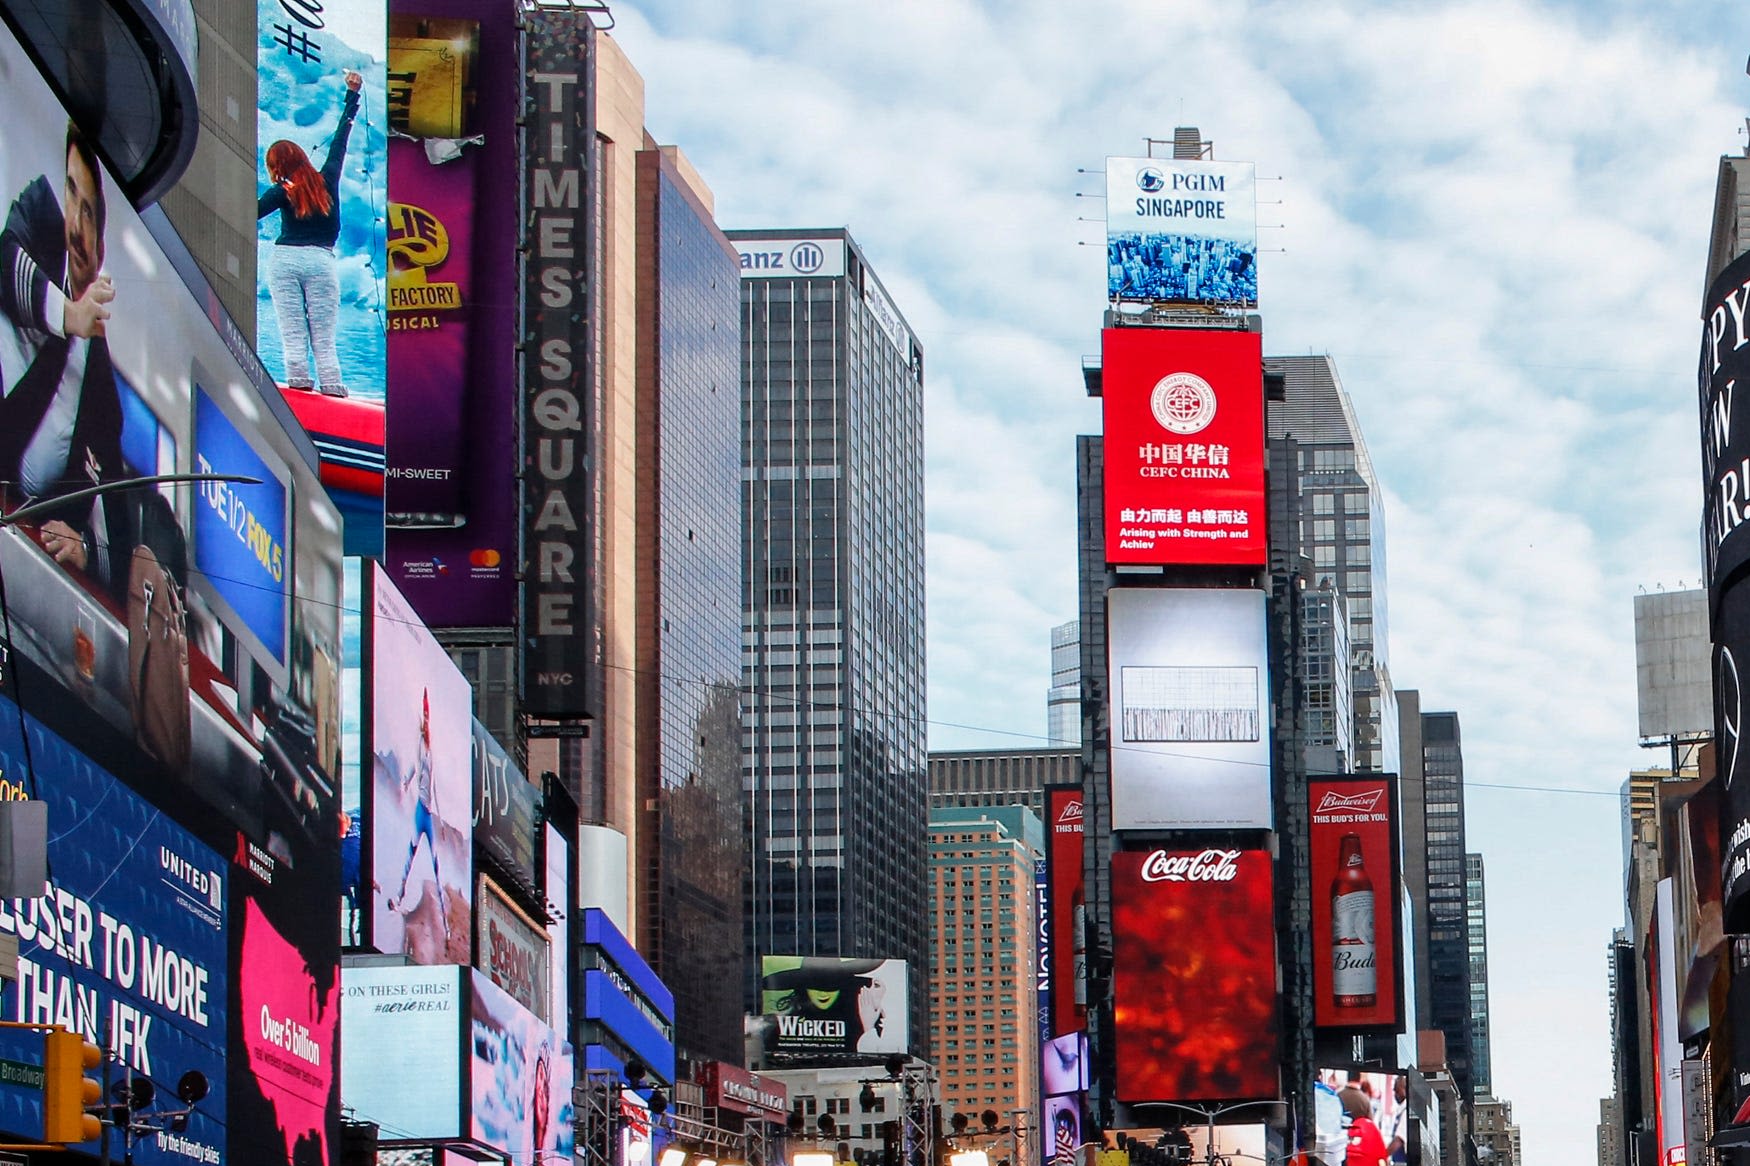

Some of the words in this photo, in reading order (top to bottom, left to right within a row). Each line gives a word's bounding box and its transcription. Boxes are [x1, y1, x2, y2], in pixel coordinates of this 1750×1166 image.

[533, 73, 580, 308] TIMES
[1173, 173, 1226, 192] PGIM
[1136, 198, 1226, 219] SINGAPORE
[391, 286, 455, 306] FACTORY
[1168, 396, 1200, 410] CEFC
[1139, 443, 1229, 465] 中国华信
[1140, 467, 1178, 477] CEFC
[1181, 467, 1230, 478] CHINA
[533, 338, 582, 635] SQUARE
[198, 452, 228, 521] TUE
[228, 489, 246, 543] 1/2
[246, 510, 273, 576] FOX
[271, 542, 283, 583] 5
[1120, 508, 1182, 523] 由力而起
[1187, 509, 1248, 524] 由善而达
[1120, 528, 1156, 538] Arising
[1158, 529, 1181, 537] with
[1183, 529, 1227, 539] Strength
[1229, 530, 1249, 538] and
[1120, 540, 1154, 549] Achiev
[537, 672, 573, 686] NYC
[1324, 795, 1377, 808] Budweiser
[1055, 824, 1073, 832] THIS
[1313, 815, 1330, 824] THIS
[1331, 815, 1352, 823] BUD'S
[1353, 814, 1370, 822] FOR
[1370, 813, 1388, 822] YOU.
[249, 842, 275, 870] MARRIOTT
[160, 846, 210, 895] UNITED
[249, 858, 272, 884] MARQUIS
[100, 911, 136, 989] TO
[142, 936, 209, 1027] MORE
[348, 987, 366, 997] ON
[369, 985, 409, 996] THESE
[411, 984, 451, 995] GIRLS!
[17, 956, 98, 1044] THAN
[110, 1000, 152, 1077] JFK
[260, 1004, 285, 1048] Over
[285, 1017, 292, 1051] 5
[292, 1021, 320, 1067] billion
[2, 1062, 45, 1090] Broadway
[158, 1131, 168, 1152] fly
[168, 1133, 180, 1152] the
[180, 1136, 205, 1163] friendly
[204, 1145, 220, 1165] skies
